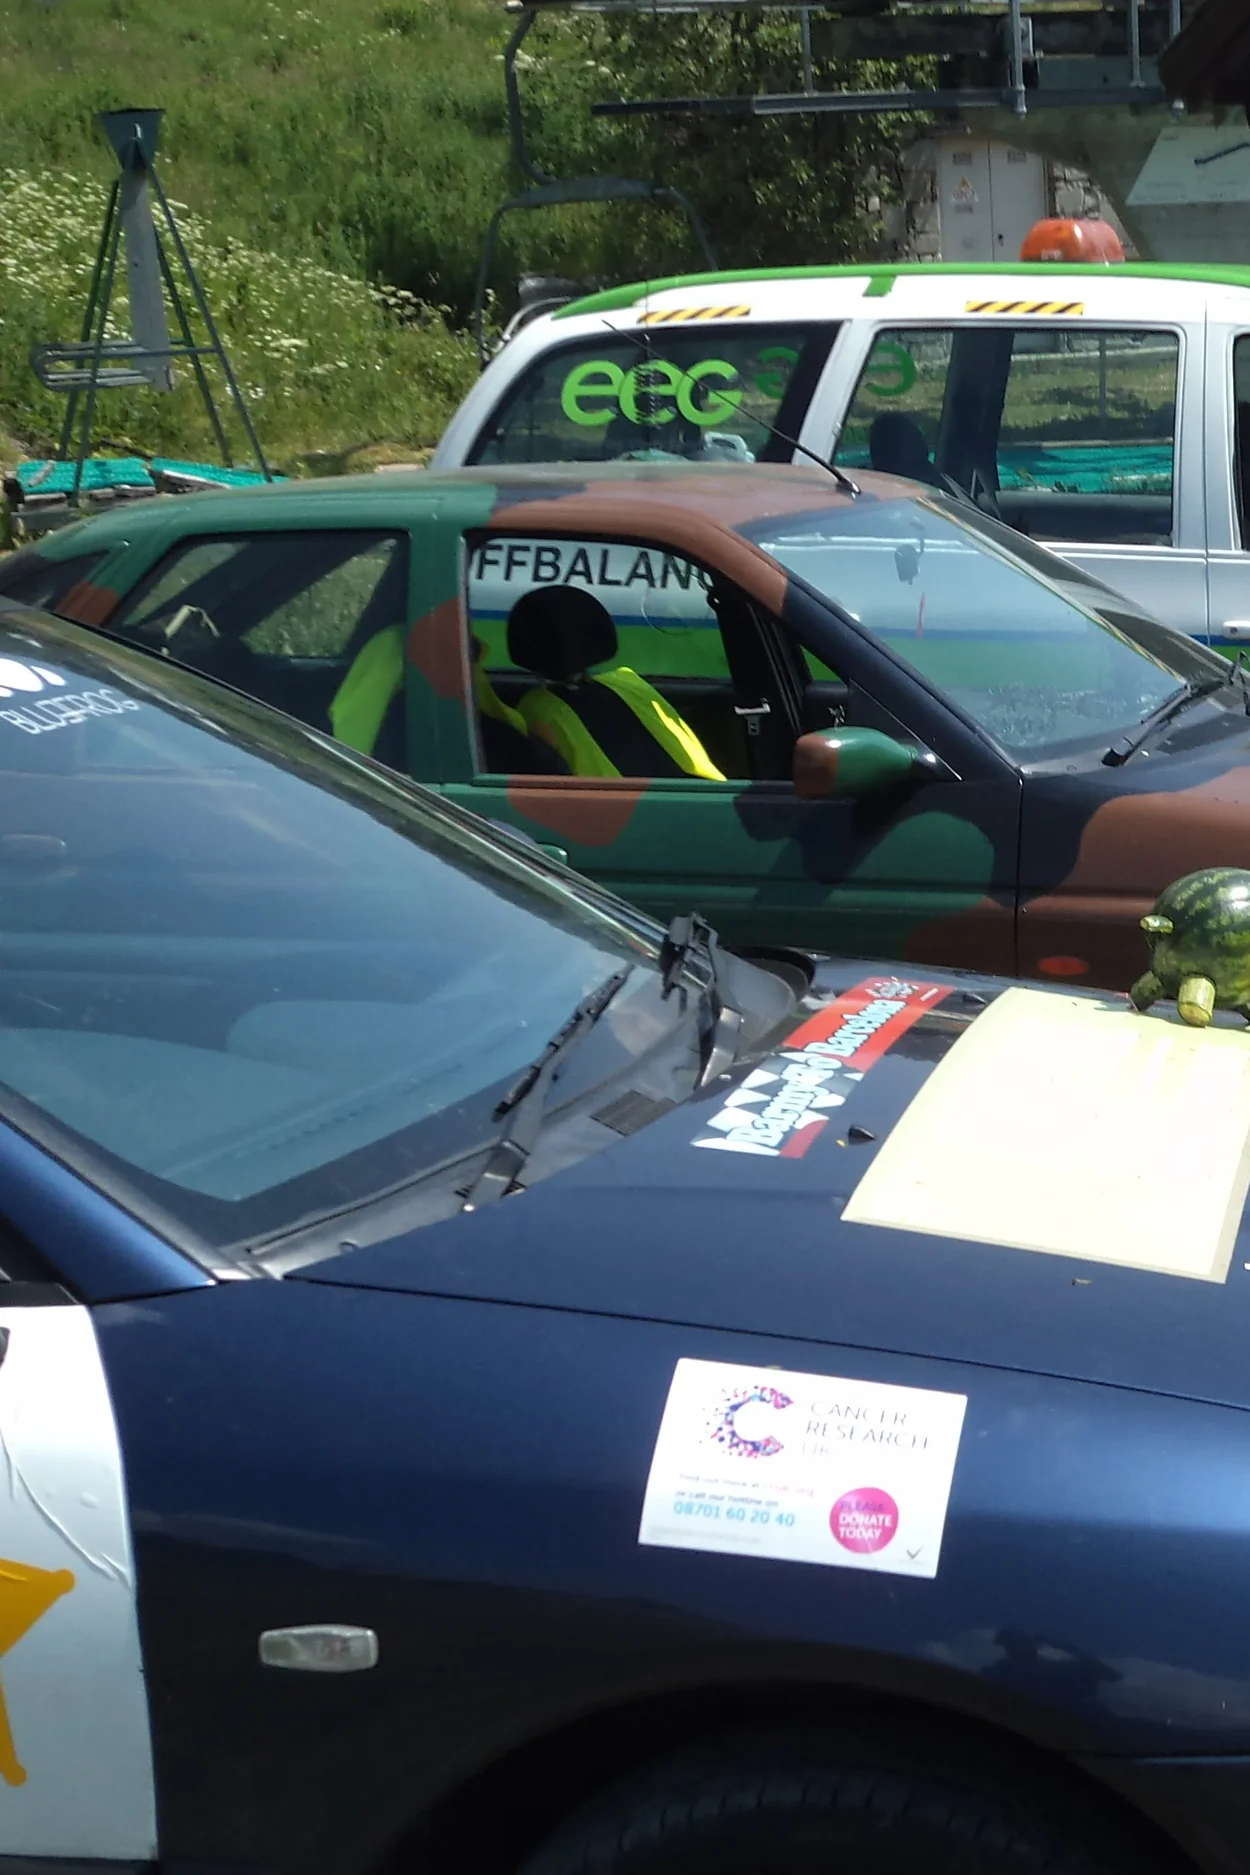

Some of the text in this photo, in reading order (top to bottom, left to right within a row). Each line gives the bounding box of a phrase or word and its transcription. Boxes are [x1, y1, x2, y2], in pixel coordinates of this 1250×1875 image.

[810, 1398, 908, 1427] CANCER
[804, 1420, 930, 1450] RESEARCH
[673, 1499, 795, 1528] 08701 60 20 40
[838, 1512, 893, 1528] DONATE
[838, 1525, 883, 1541] TODAY
